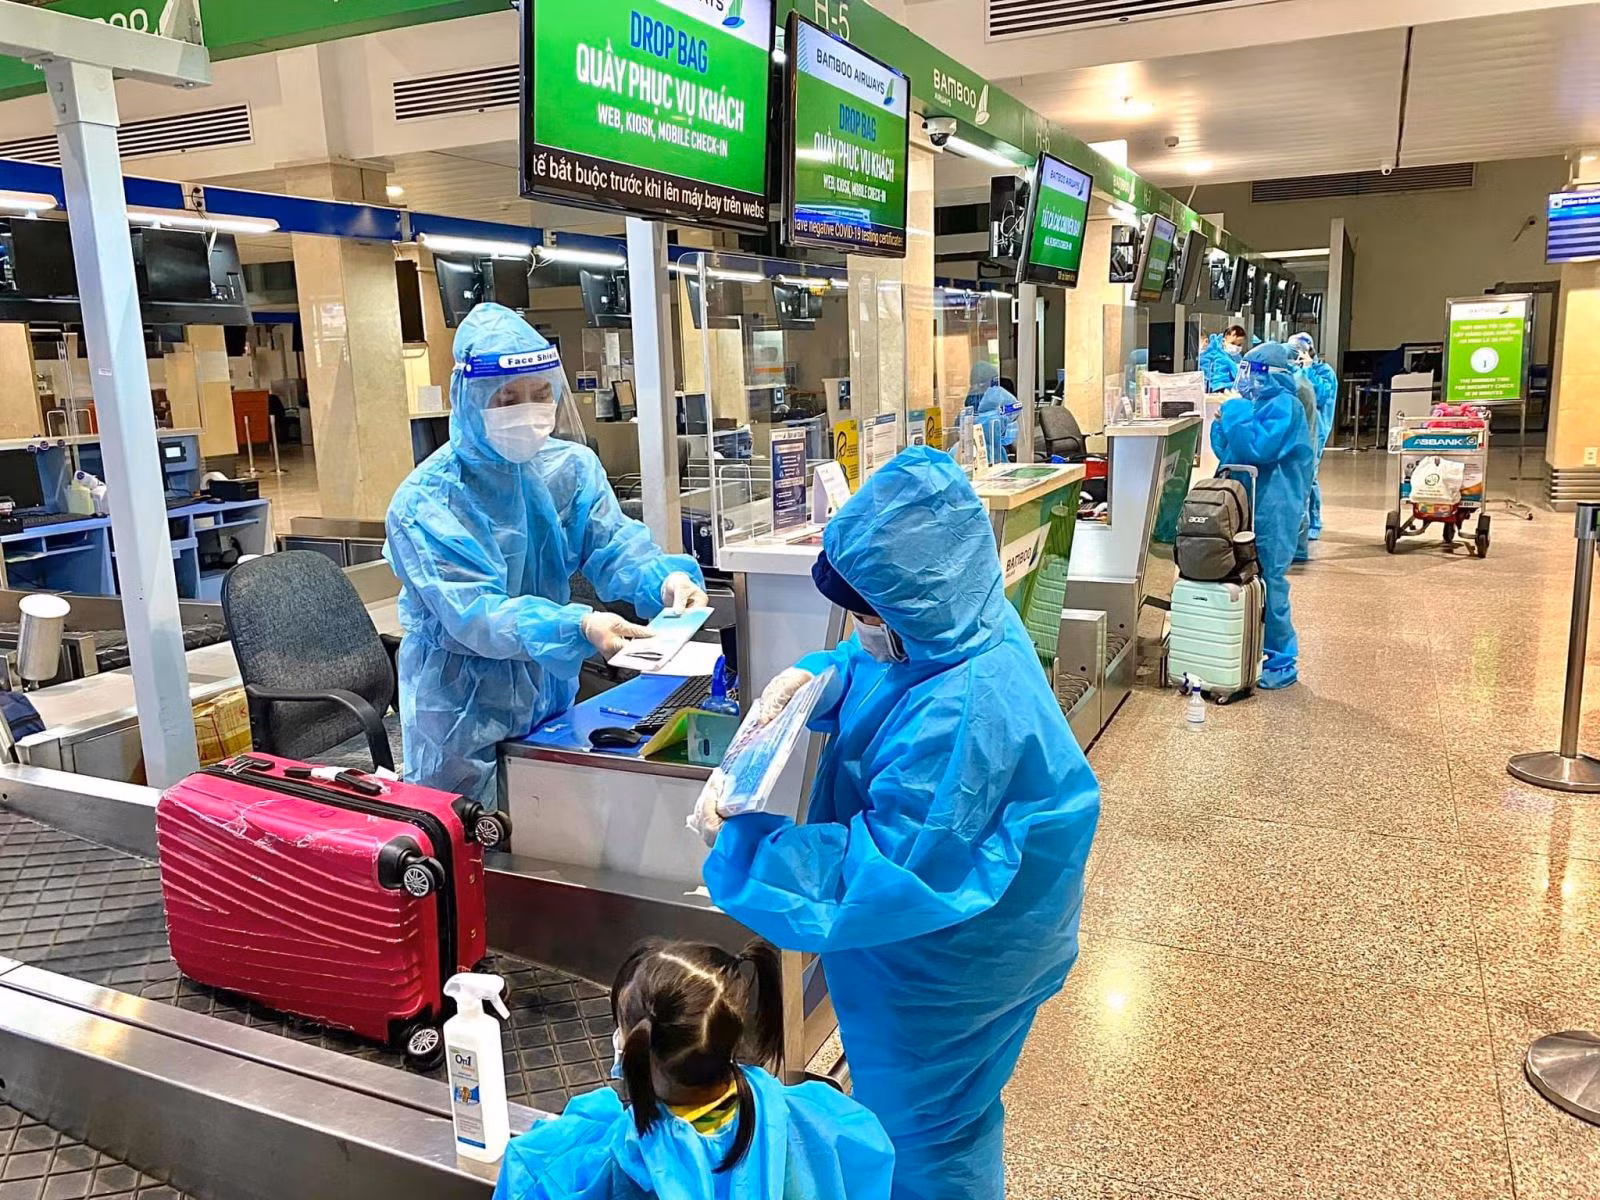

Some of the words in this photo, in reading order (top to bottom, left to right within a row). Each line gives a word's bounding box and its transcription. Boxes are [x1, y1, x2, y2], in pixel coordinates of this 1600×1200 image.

[631, 10, 675, 59] DROP
[677, 30, 708, 74] BAG
[816, 48, 853, 78] BAMBOO
[853, 69, 886, 95] AIRWAYS
[933, 68, 977, 109] BAMBOO
[628, 60, 673, 115] PHỤC
[674, 77, 697, 125] VỤ
[698, 84, 745, 132] KHÁCH
[597, 102, 624, 134] WEB,
[625, 111, 656, 143] KIOSK,
[658, 120, 691, 148] MOBILE
[691, 131, 729, 158] CHECK-IN
[839, 103, 861, 135] DROP
[861, 114, 877, 142] BAG
[838, 139, 860, 177] PHỤC
[860, 147, 871, 182] VỤ
[871, 149, 895, 183] KHÁCH
[533, 152, 547, 177] tế
[549, 155, 572, 182] bắt
[575, 161, 608, 190] buộc
[610, 171, 643, 195] trước
[644, 176, 661, 199] khi
[663, 180, 680, 203] lên
[681, 187, 703, 211] máy
[704, 190, 722, 214] bay
[723, 195, 741, 214] trên
[835, 223, 860, 239] COVID-19
[507, 356, 534, 366] Face
[1188, 516, 1208, 524] acer
[1006, 547, 1032, 572] BAMBOO
